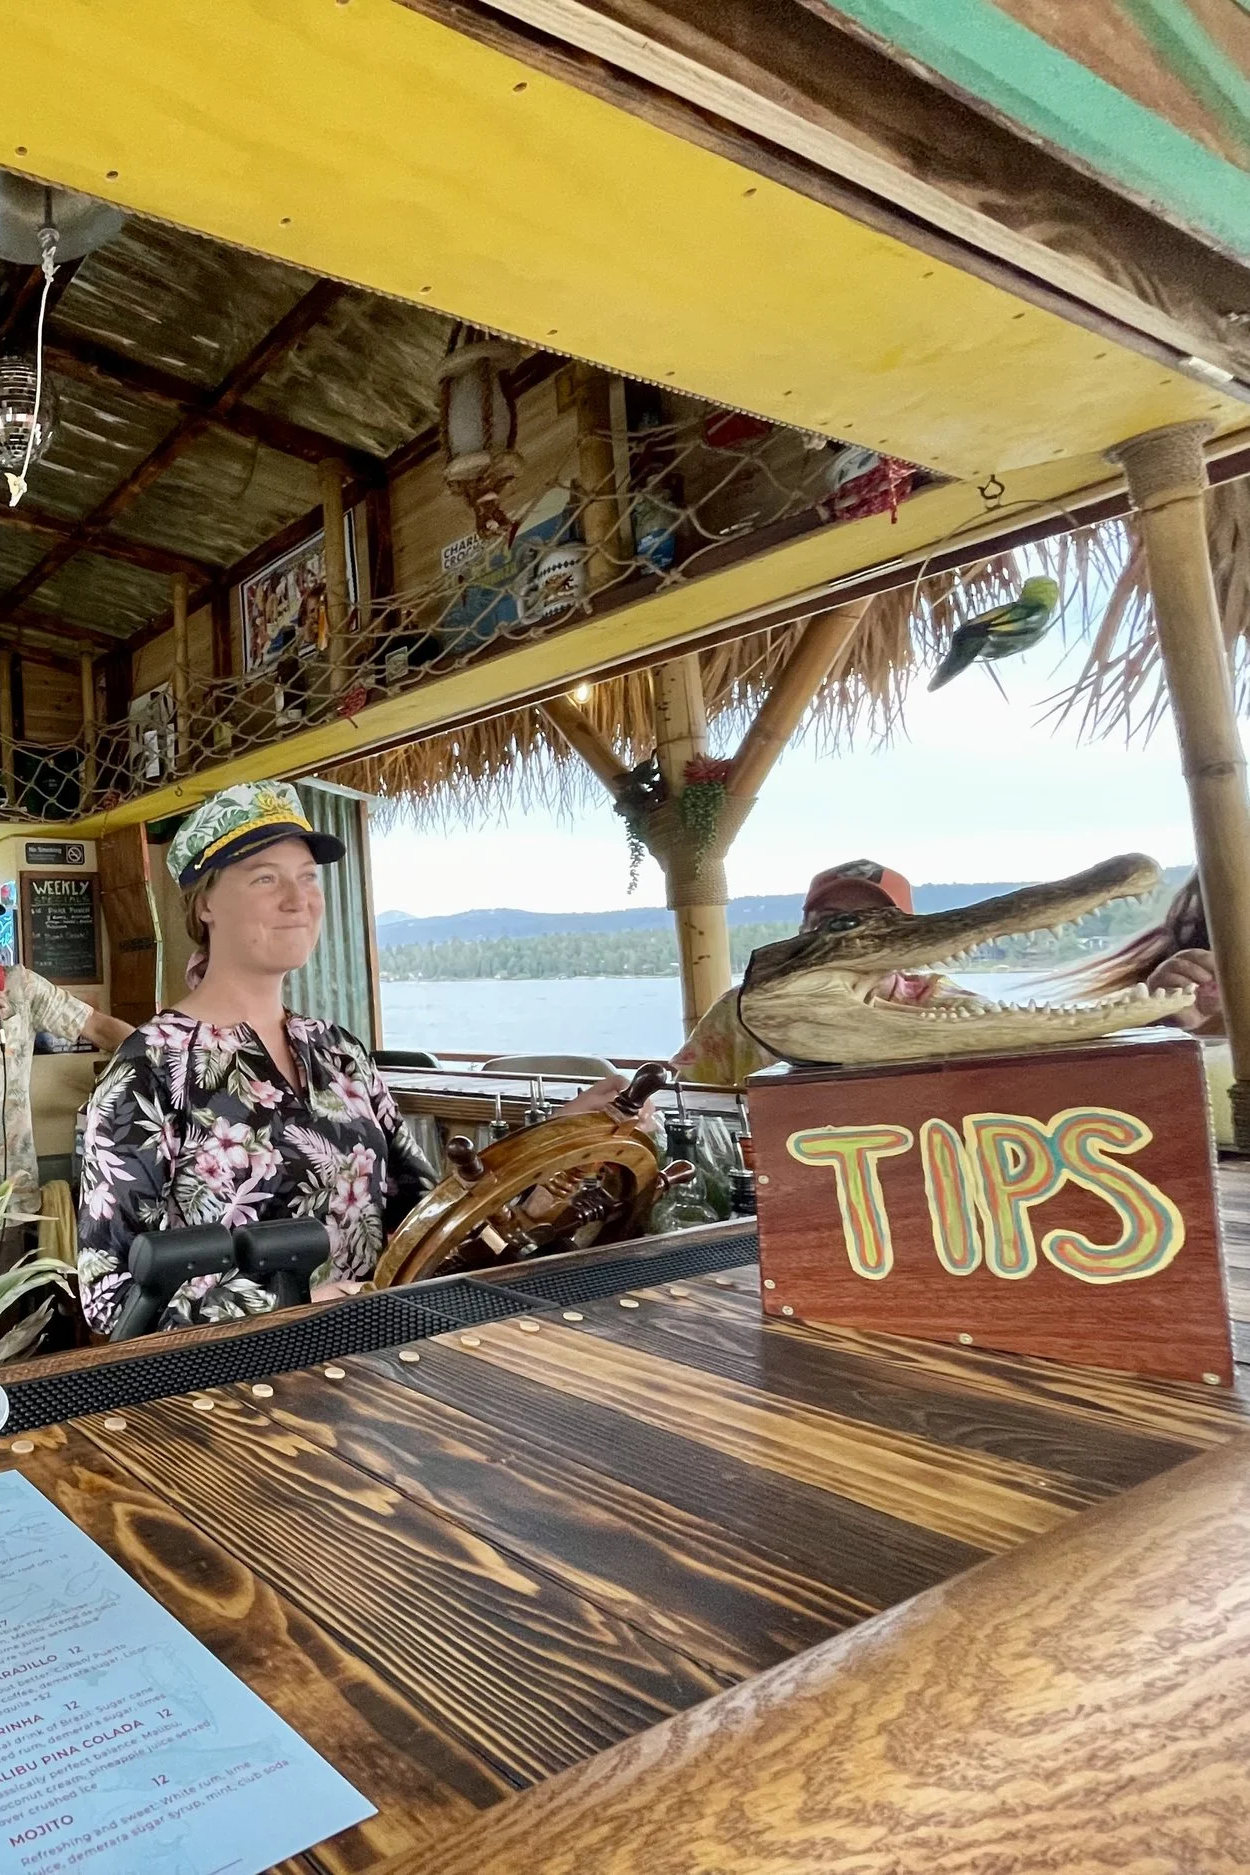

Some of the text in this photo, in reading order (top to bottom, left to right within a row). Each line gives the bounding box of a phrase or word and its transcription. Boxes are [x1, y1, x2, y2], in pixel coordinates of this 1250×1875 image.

[32, 880, 90, 895] WEEKLY
[786, 1106, 1186, 1285] TIPS
[39, 1668, 89, 1690] demerara
[68, 1645, 83, 1655] 12
[92, 1644, 126, 1659] Puerto
[14, 1729, 45, 1744] drink
[46, 1722, 58, 1733] of
[96, 1697, 126, 1714] Sugar
[129, 1686, 154, 1699] cane
[19, 1742, 47, 1755] rum,
[48, 1719, 101, 1744] demerara
[102, 1705, 138, 1723] sugar,
[138, 1693, 167, 1708] limes
[63, 1701, 80, 1711] 12
[41, 1745, 81, 1766] PINA
[82, 1719, 145, 1749] COLADA
[156, 1708, 174, 1720] 12
[46, 1773, 87, 1794] cream,
[89, 1749, 145, 1777] pineapple
[147, 1736, 174, 1754] juice
[175, 1719, 211, 1738] served
[49, 1757, 91, 1780] perfect
[142, 1721, 183, 1740] Malibu,
[9, 1774, 170, 1848] MOJITO 12
[21, 1760, 251, 1867] Refreshing and White rum, lime
[28, 1792, 78, 1816] crushed
[80, 1782, 98, 1794] ice
[68, 1759, 290, 1865] demerara sugar syrup, mint, club soda
